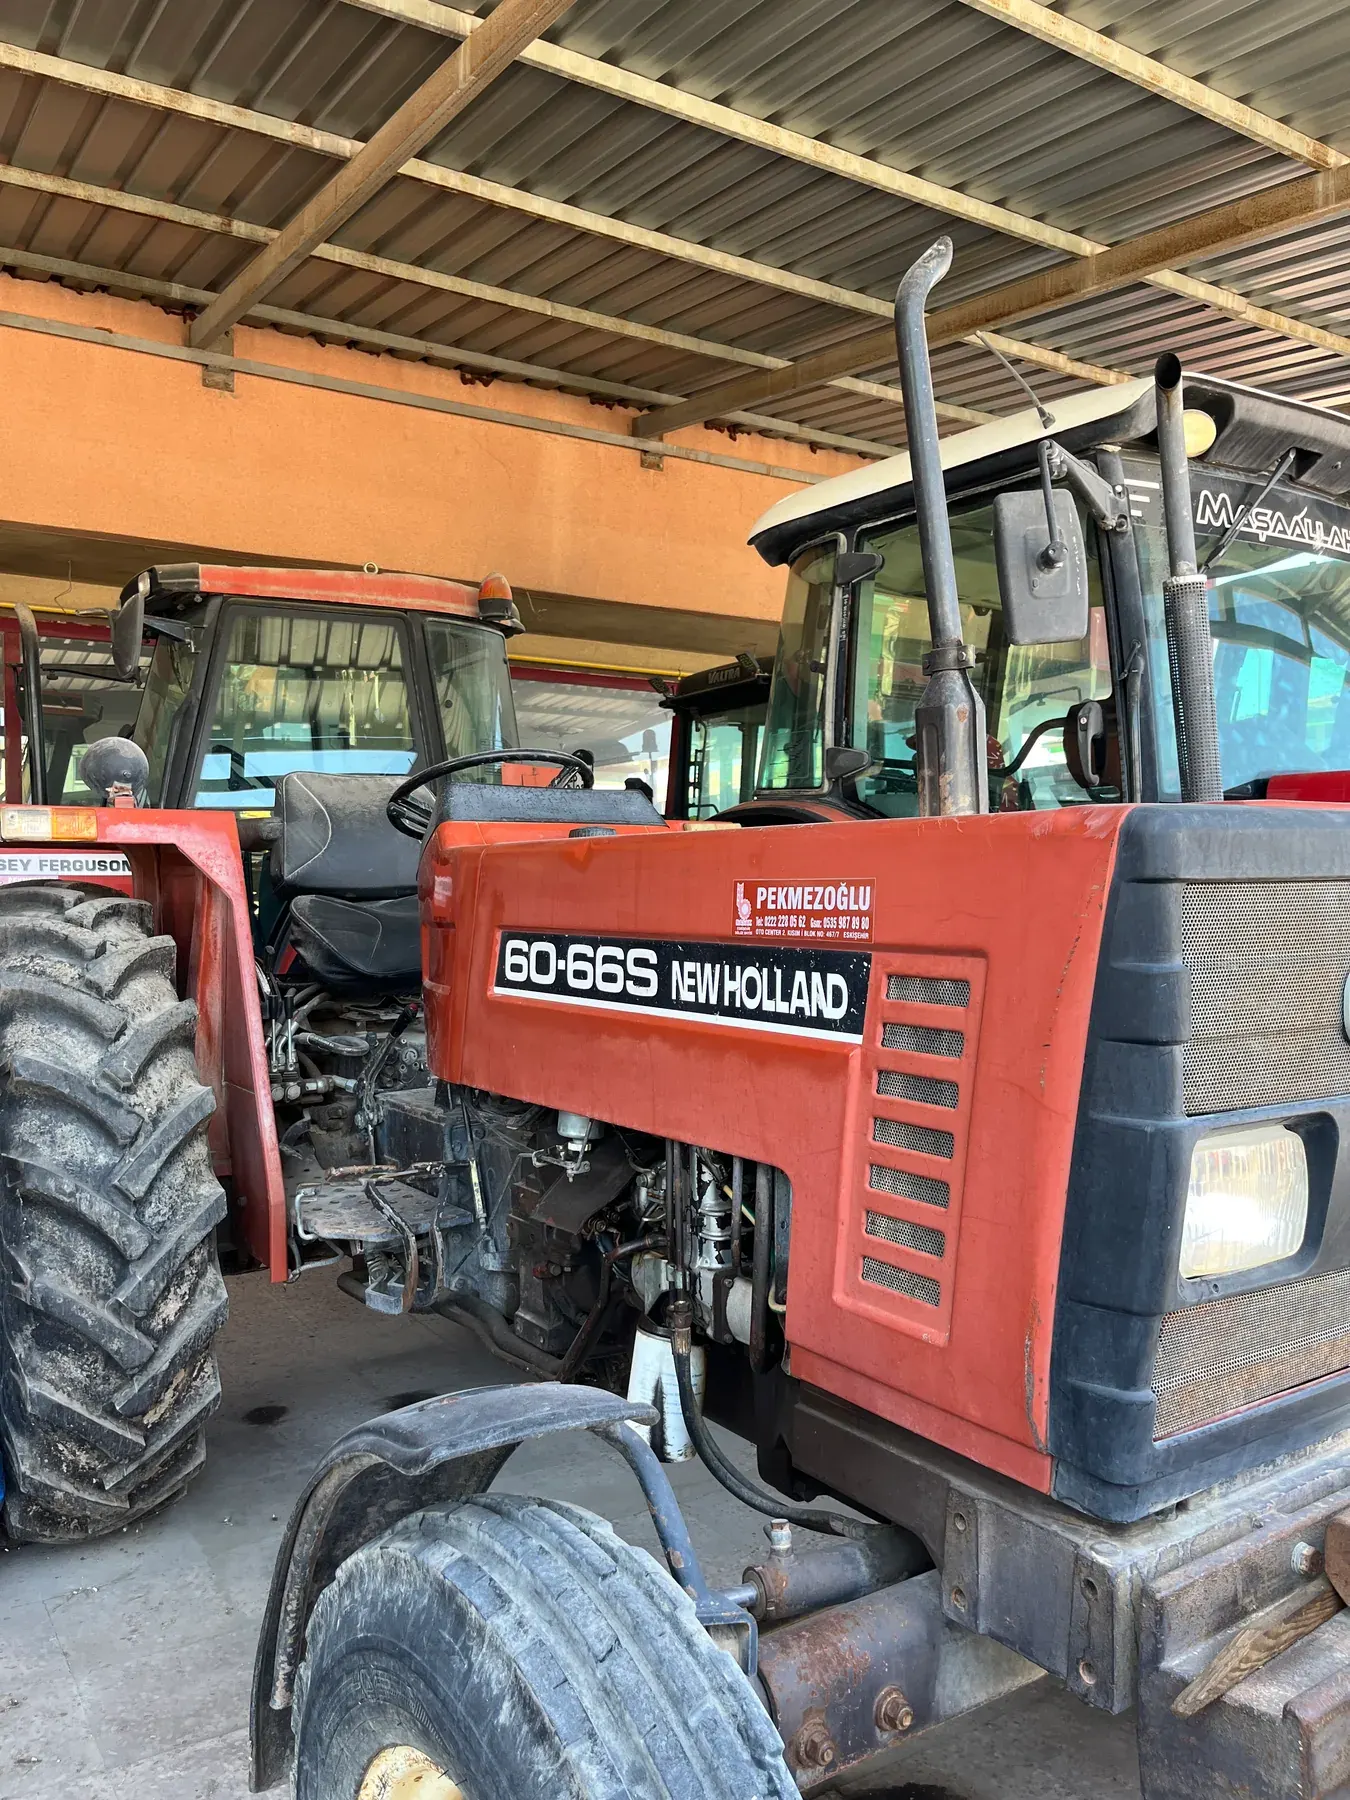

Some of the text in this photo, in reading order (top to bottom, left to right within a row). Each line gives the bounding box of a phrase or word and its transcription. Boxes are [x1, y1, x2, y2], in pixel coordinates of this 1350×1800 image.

[708, 667, 741, 685] VALTRA
[39, 859, 131, 872] FERGUSON
[756, 882, 871, 911] PEKMEZOĞLU
[777, 915, 788, 927] 228
[789, 915, 797, 928] 05
[798, 915, 806, 928] 62
[838, 916, 850, 929] 987
[851, 916, 860, 930] 89
[861, 917, 870, 930] 80
[843, 931, 869, 940] ESKİŞEHİR
[504, 938, 659, 998] 60-66S
